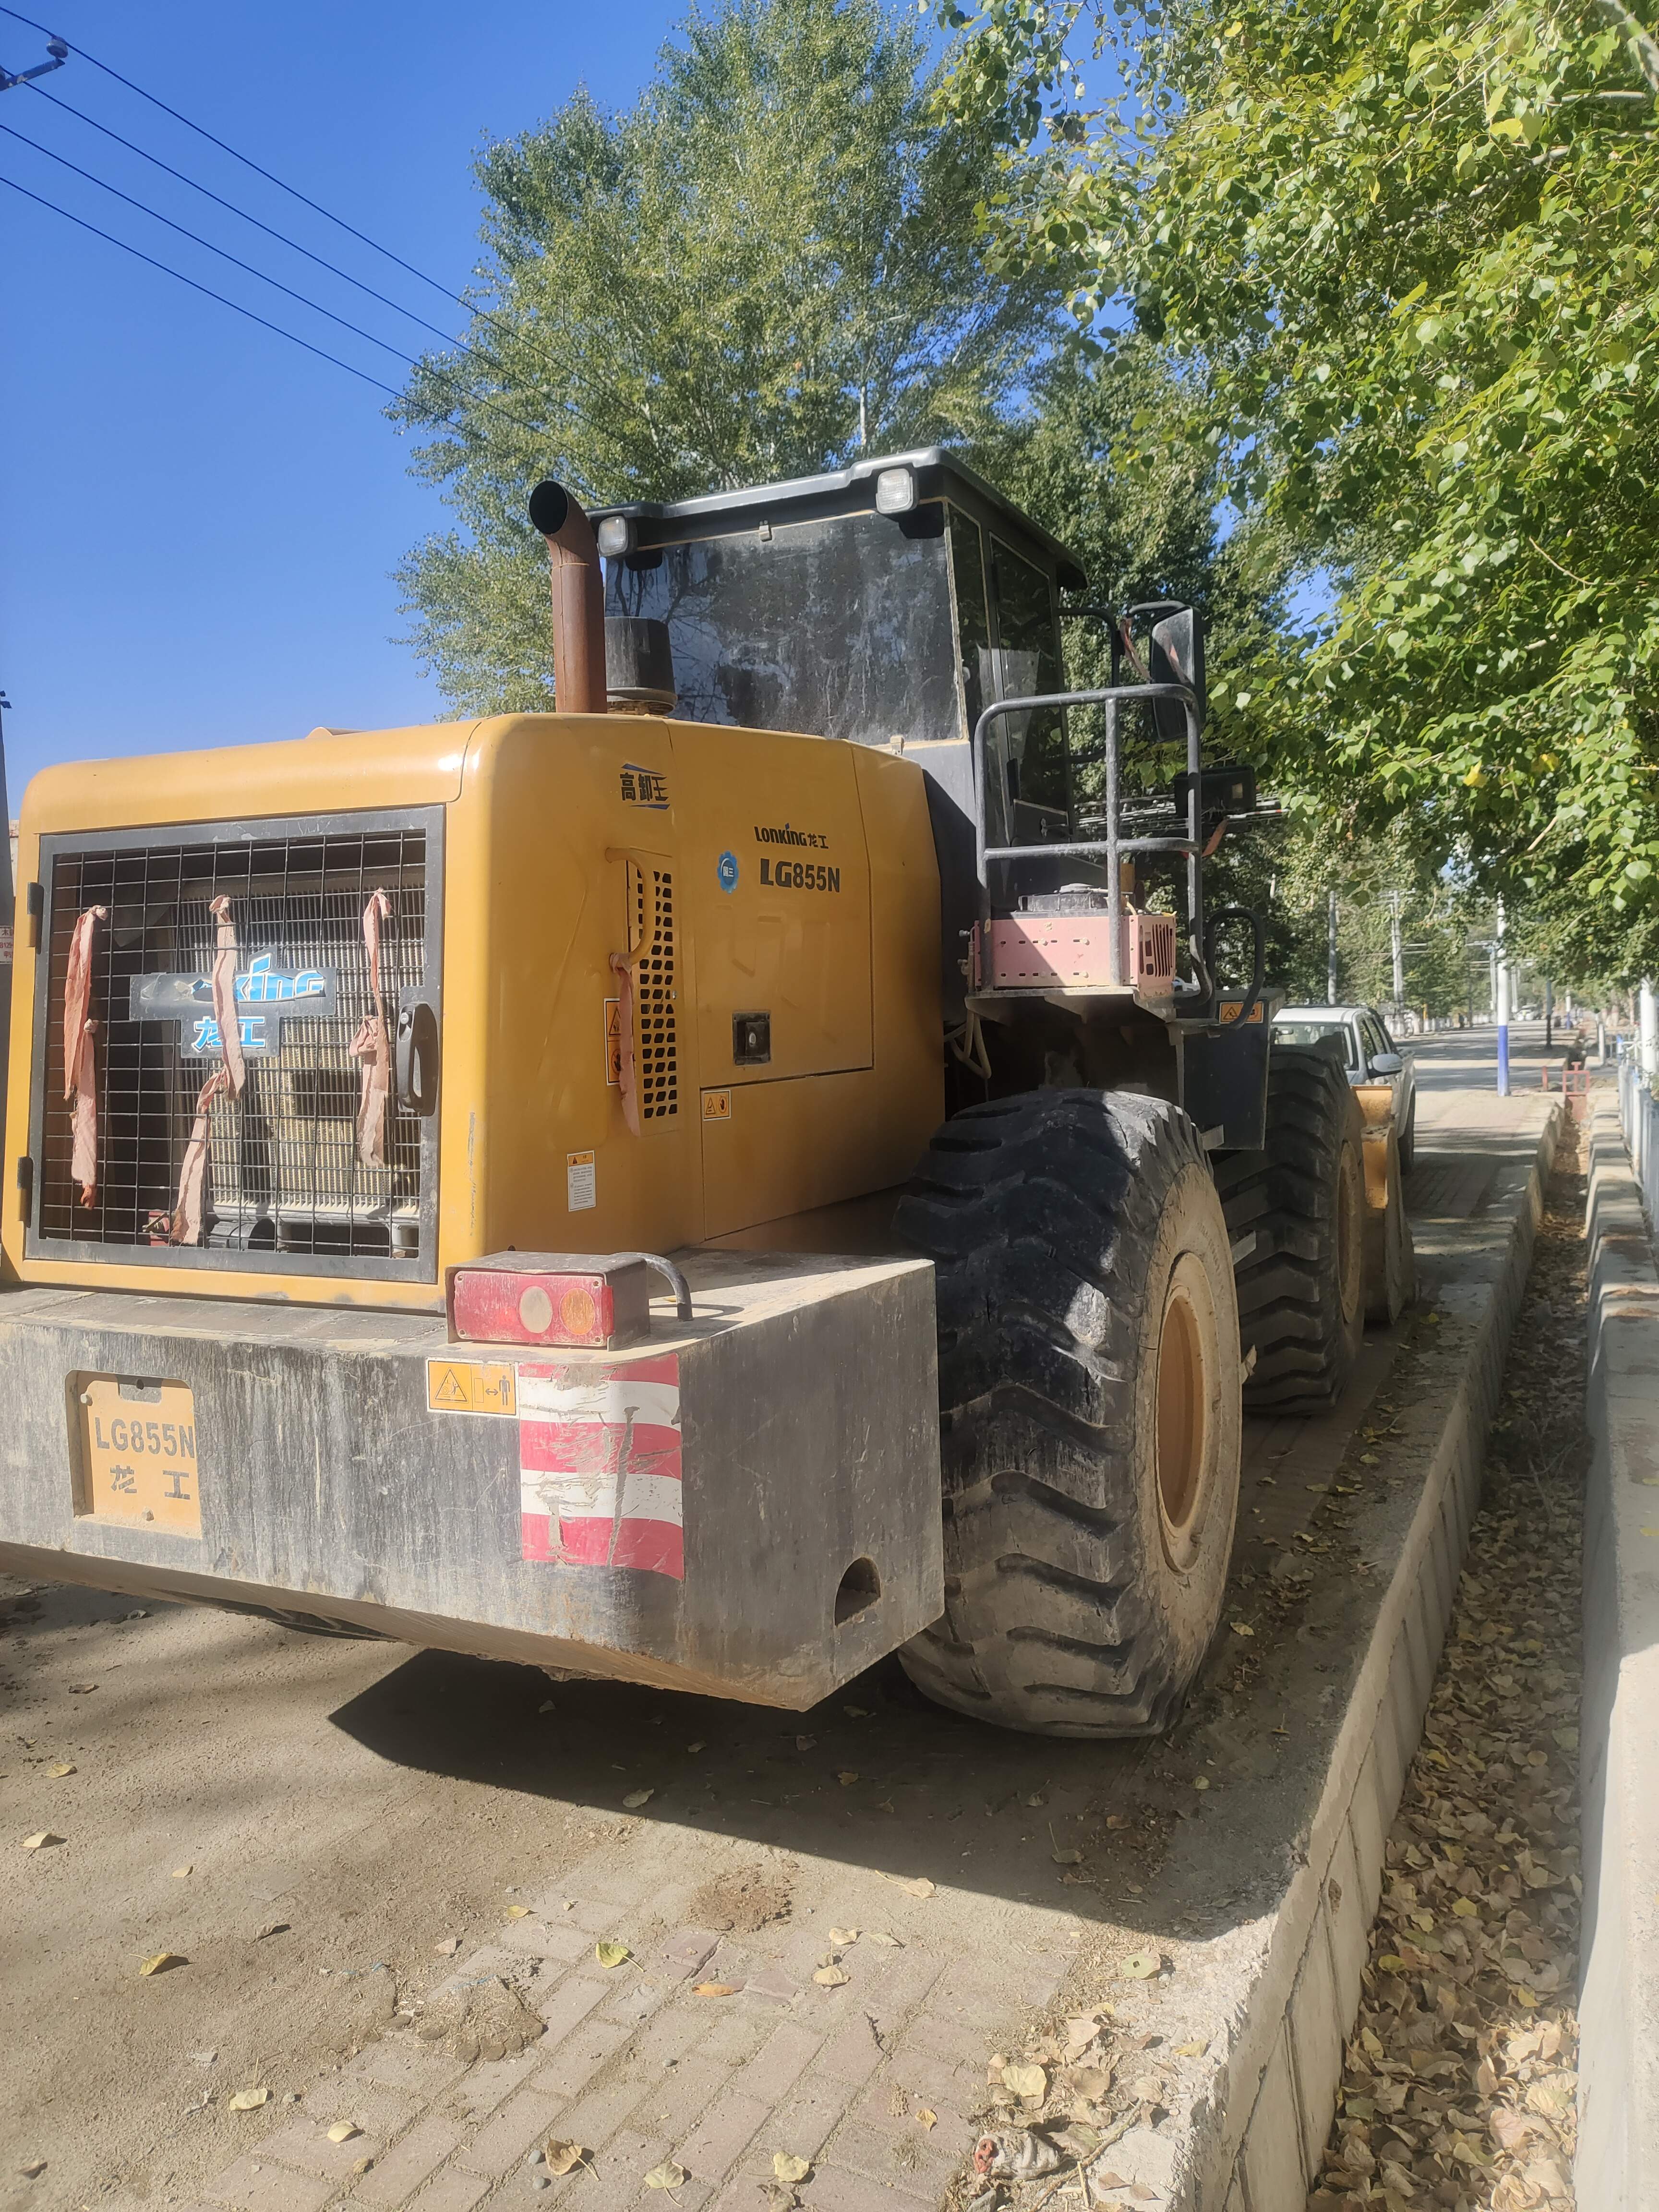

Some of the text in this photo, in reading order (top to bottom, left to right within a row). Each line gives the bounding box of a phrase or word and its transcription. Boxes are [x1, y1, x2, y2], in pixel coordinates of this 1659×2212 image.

[620, 772, 669, 801] 高卸王
[807, 833, 829, 849] 龙工
[760, 858, 840, 893] LG855N
[95, 1417, 195, 1459] LG855N
